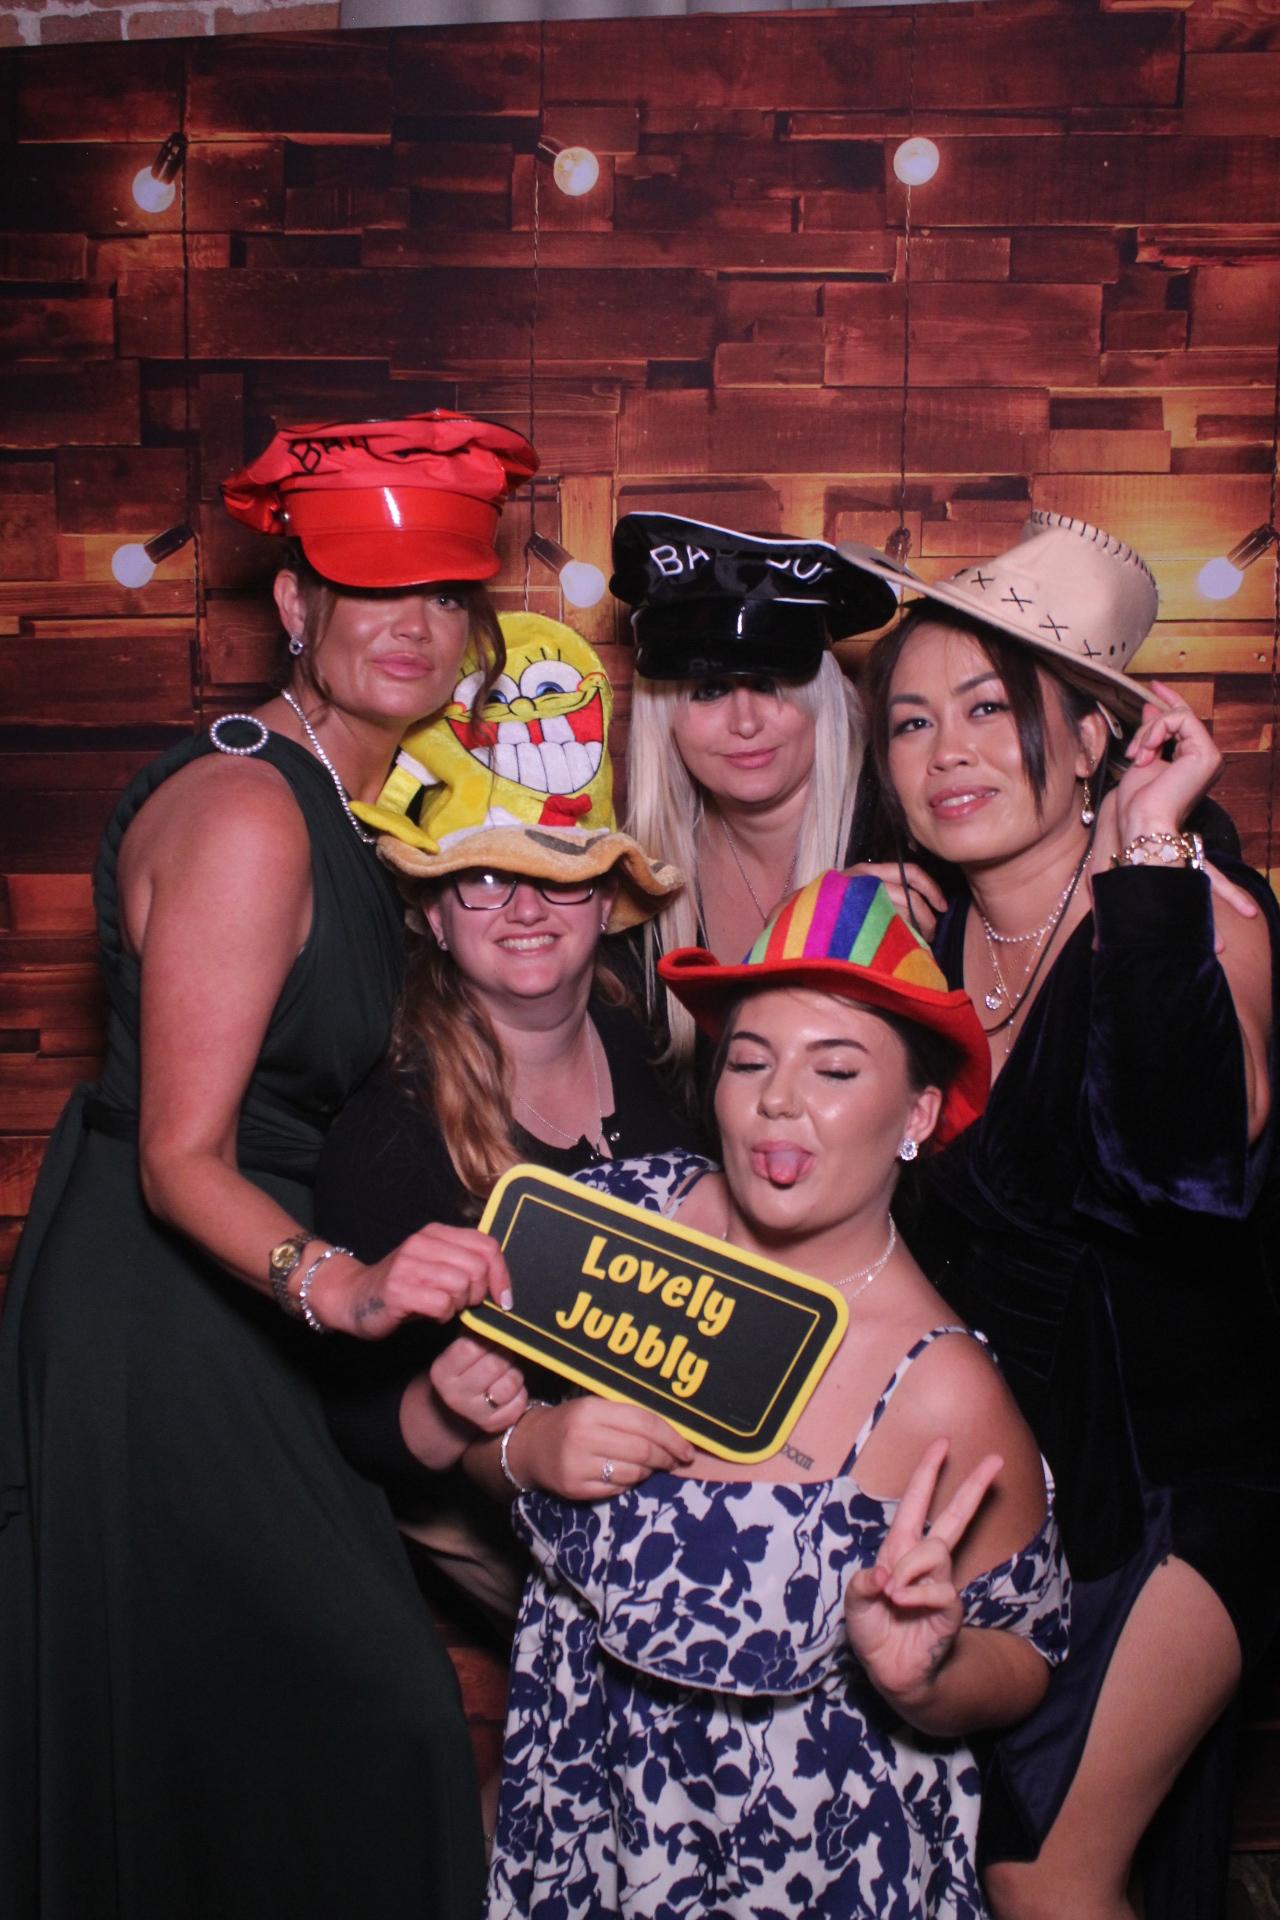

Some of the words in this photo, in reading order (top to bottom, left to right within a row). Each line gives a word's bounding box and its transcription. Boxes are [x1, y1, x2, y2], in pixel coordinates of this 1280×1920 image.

[650, 545, 737, 576] BA
[582, 1236, 735, 1336] Lovely
[555, 1291, 709, 1398] Jubbly
